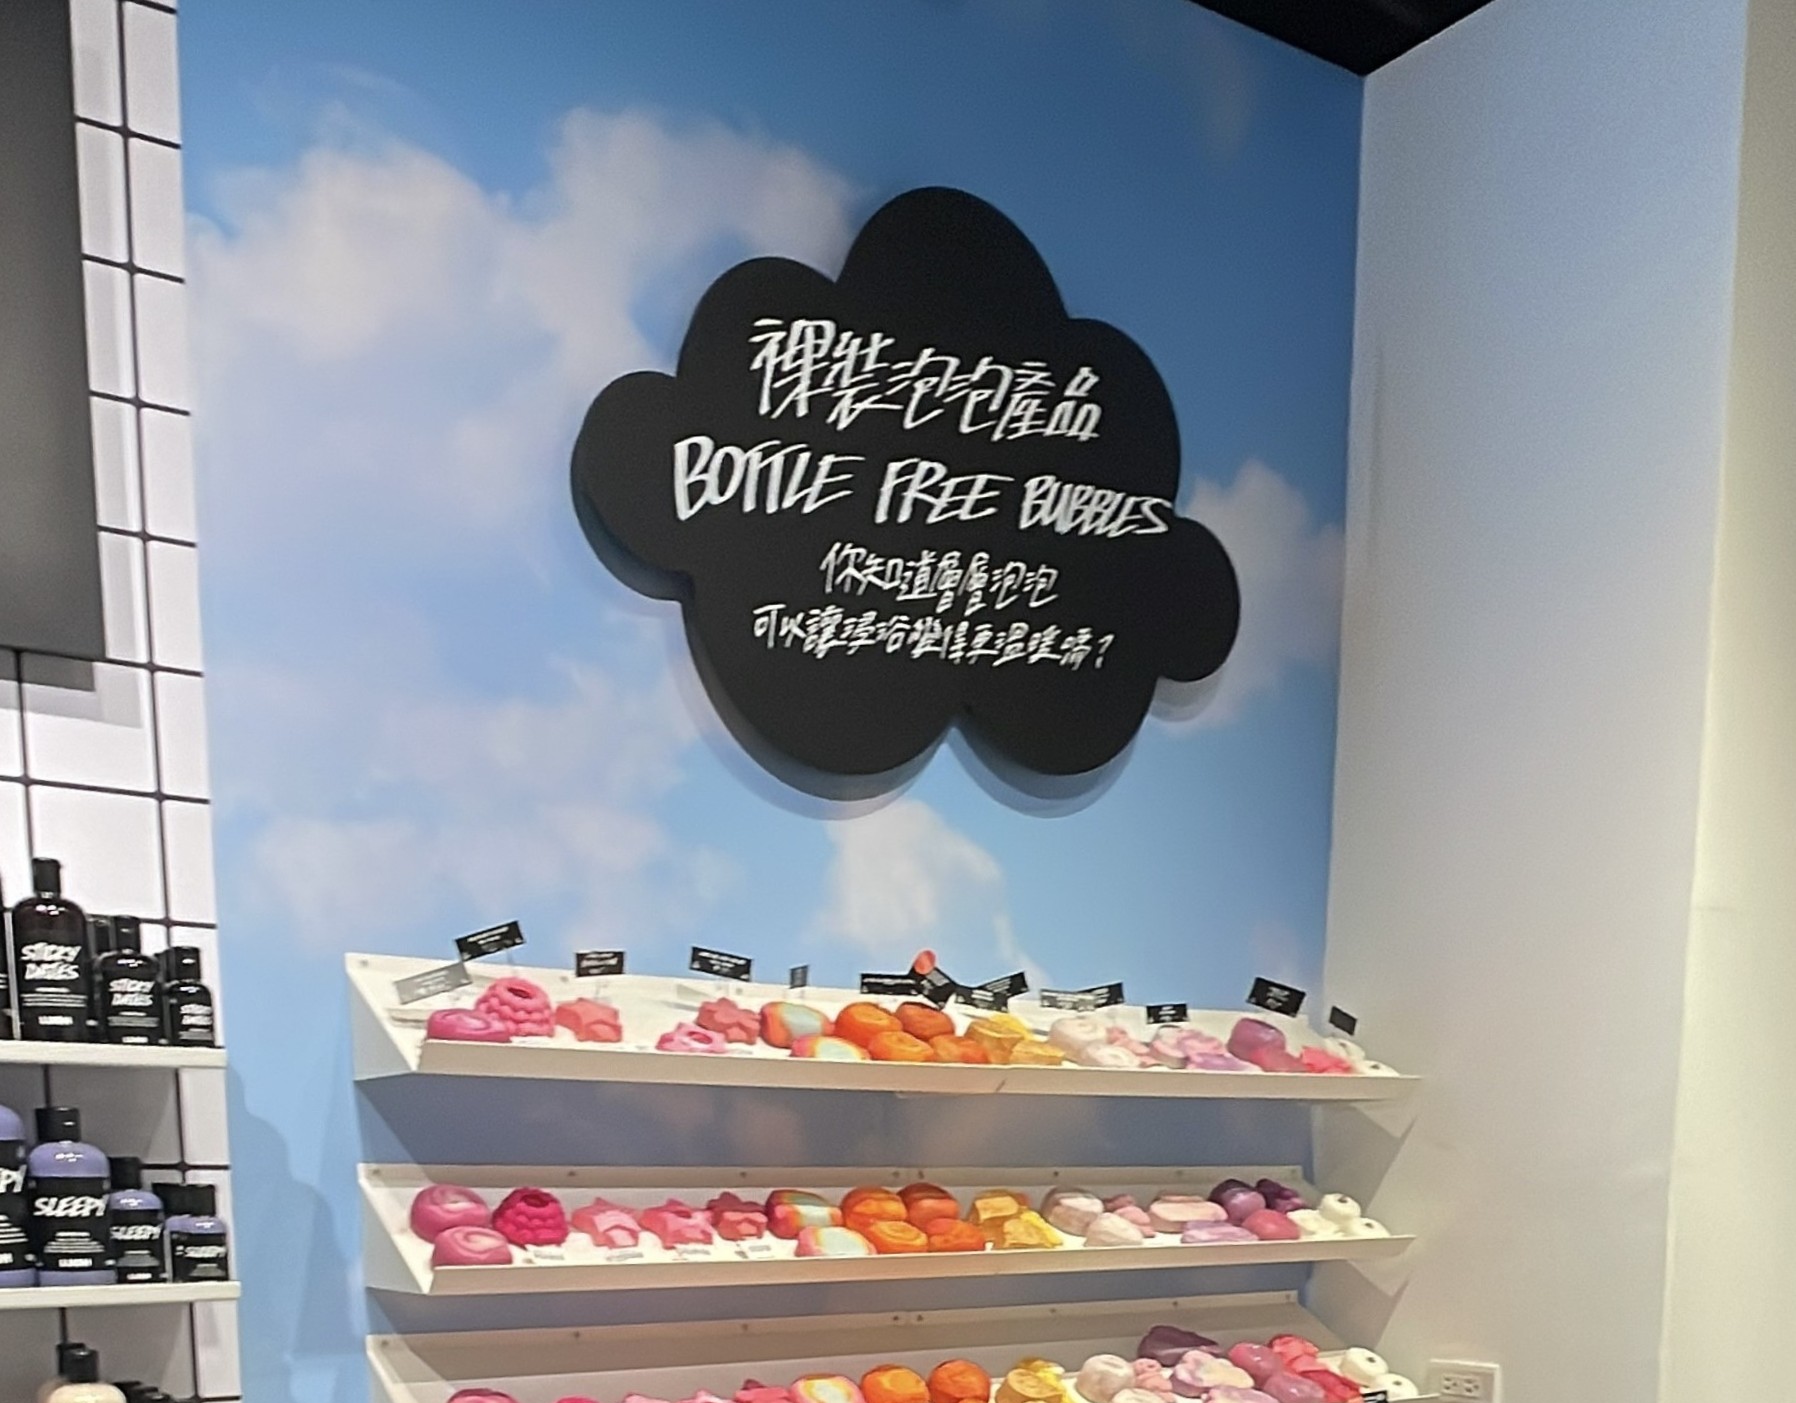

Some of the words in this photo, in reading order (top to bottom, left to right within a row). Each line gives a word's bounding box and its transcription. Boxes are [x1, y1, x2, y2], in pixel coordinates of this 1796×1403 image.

[748, 318, 1102, 442] 裸裝泡泡產品
[674, 435, 865, 520] BOTTLE
[874, 458, 1014, 523] FREE
[1018, 475, 1172, 537] BUBBLES
[819, 541, 1059, 616] 你知道層層泡泡
[33, 1194, 110, 1217] SLEEPY
[110, 1222, 164, 1240] SLEEPY
